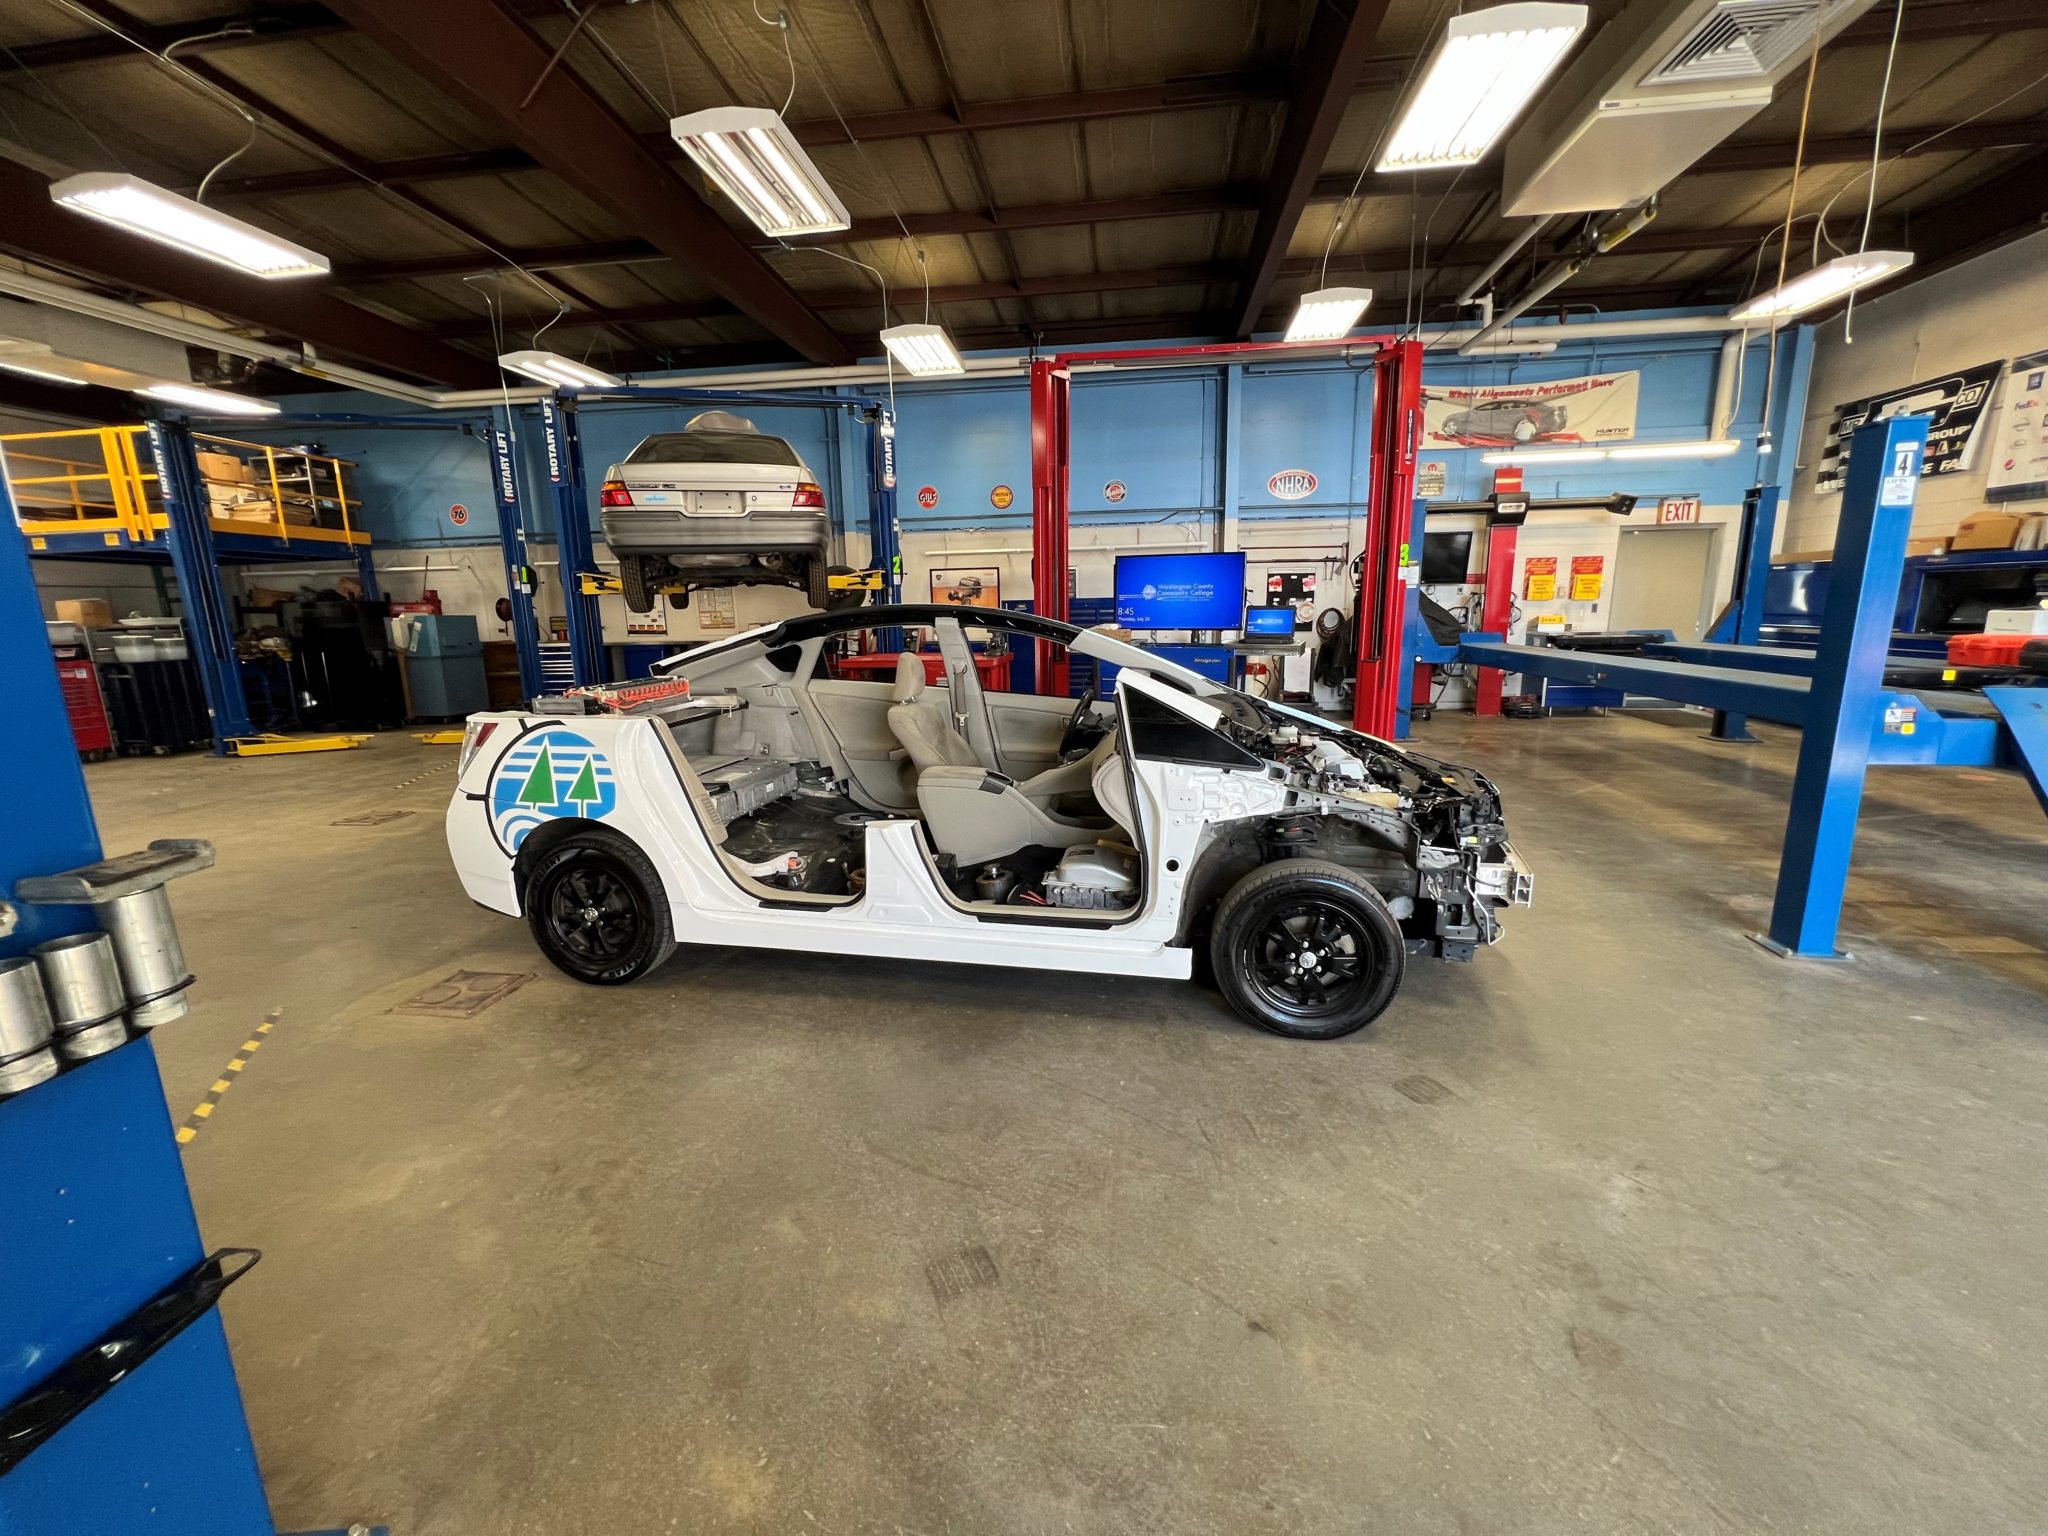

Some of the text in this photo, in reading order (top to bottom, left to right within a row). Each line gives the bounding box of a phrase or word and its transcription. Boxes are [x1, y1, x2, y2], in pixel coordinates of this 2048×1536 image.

[1448, 390, 1477, 399] Wheel
[1479, 388, 1534, 400] Alignments
[1536, 381, 1588, 395] Performed
[542, 397, 560, 476] ROTARY LIFT
[1596, 427, 1630, 435] HUNTER
[496, 431, 515, 497] ROTARY LIFT
[884, 437, 895, 481] ROTARY
[1897, 453, 1909, 476] 4
[153, 448, 170, 492] ROTARY
[1276, 475, 1310, 493] NHRA
[918, 492, 937, 505] GULF
[453, 509, 464, 519] 76
[1664, 502, 1694, 522] EXIT
[893, 555, 901, 574] 2
[1156, 590, 1189, 598] Community
[1157, 583, 1214, 592] Washington County
[1117, 607, 1135, 616] 8:45
